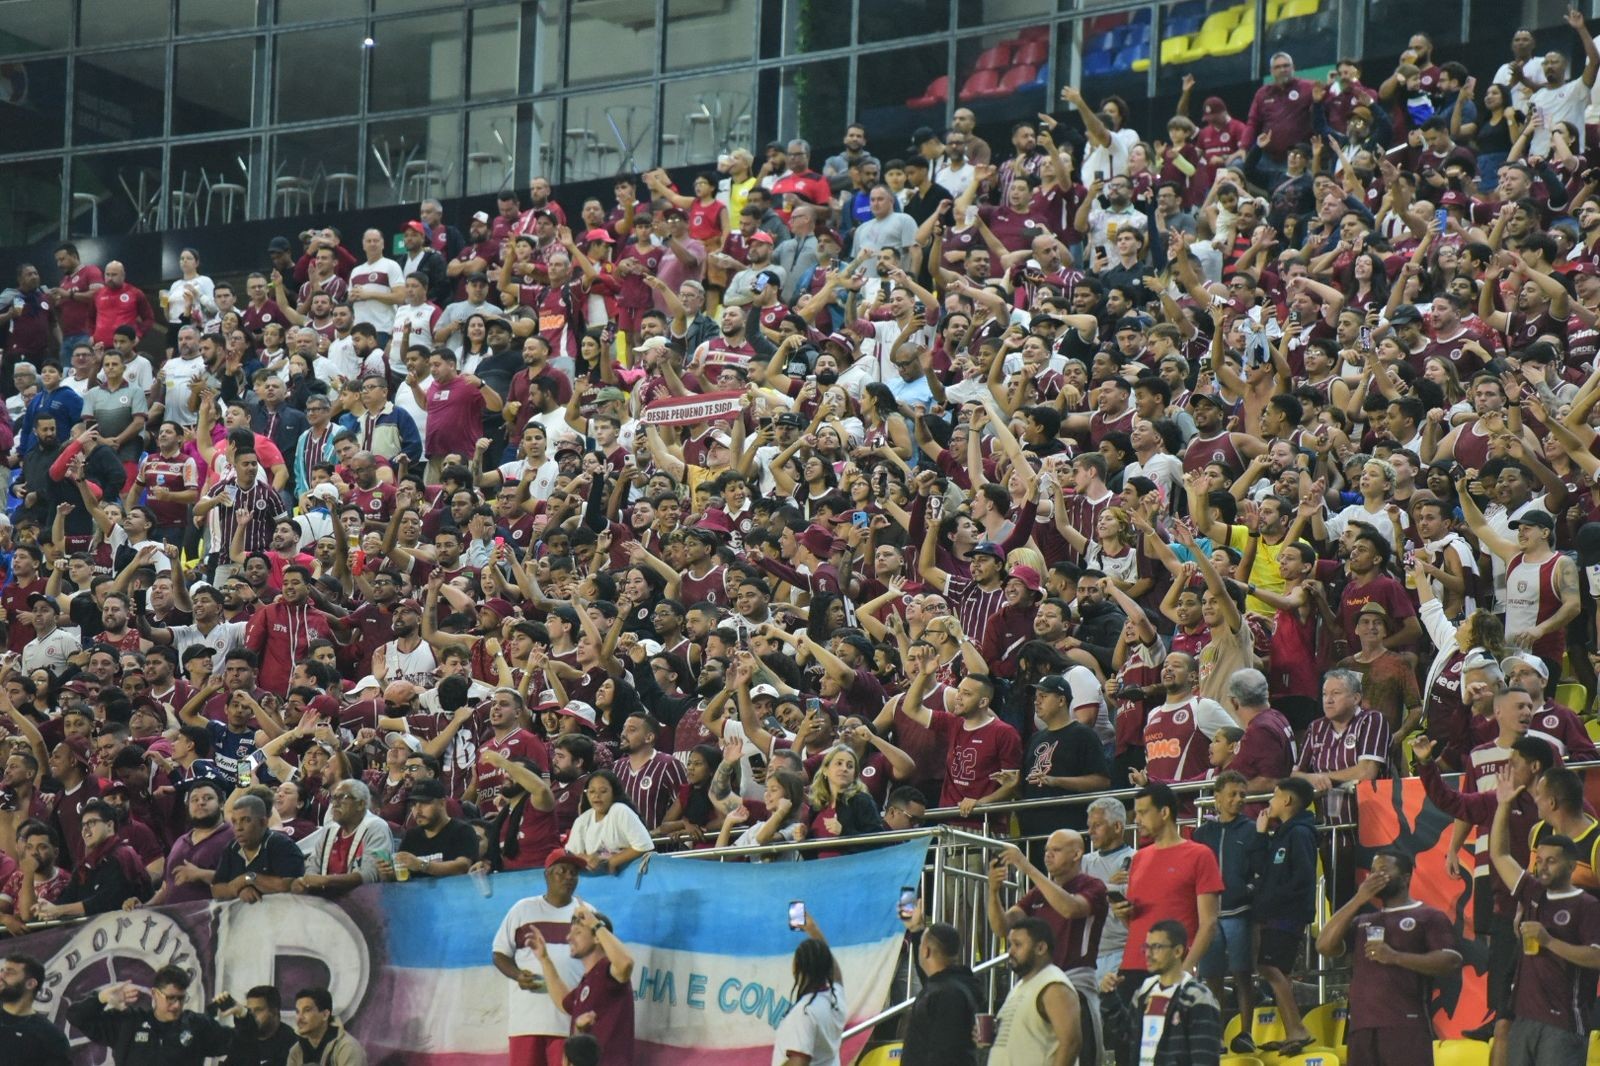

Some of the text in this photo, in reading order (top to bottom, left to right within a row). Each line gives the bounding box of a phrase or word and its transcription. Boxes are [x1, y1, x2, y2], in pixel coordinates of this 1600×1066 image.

[647, 401, 733, 421] DESDE PEQUENO TE SIGO
[1146, 737, 1181, 761] BMG
[632, 965, 792, 1031] HA E CON
